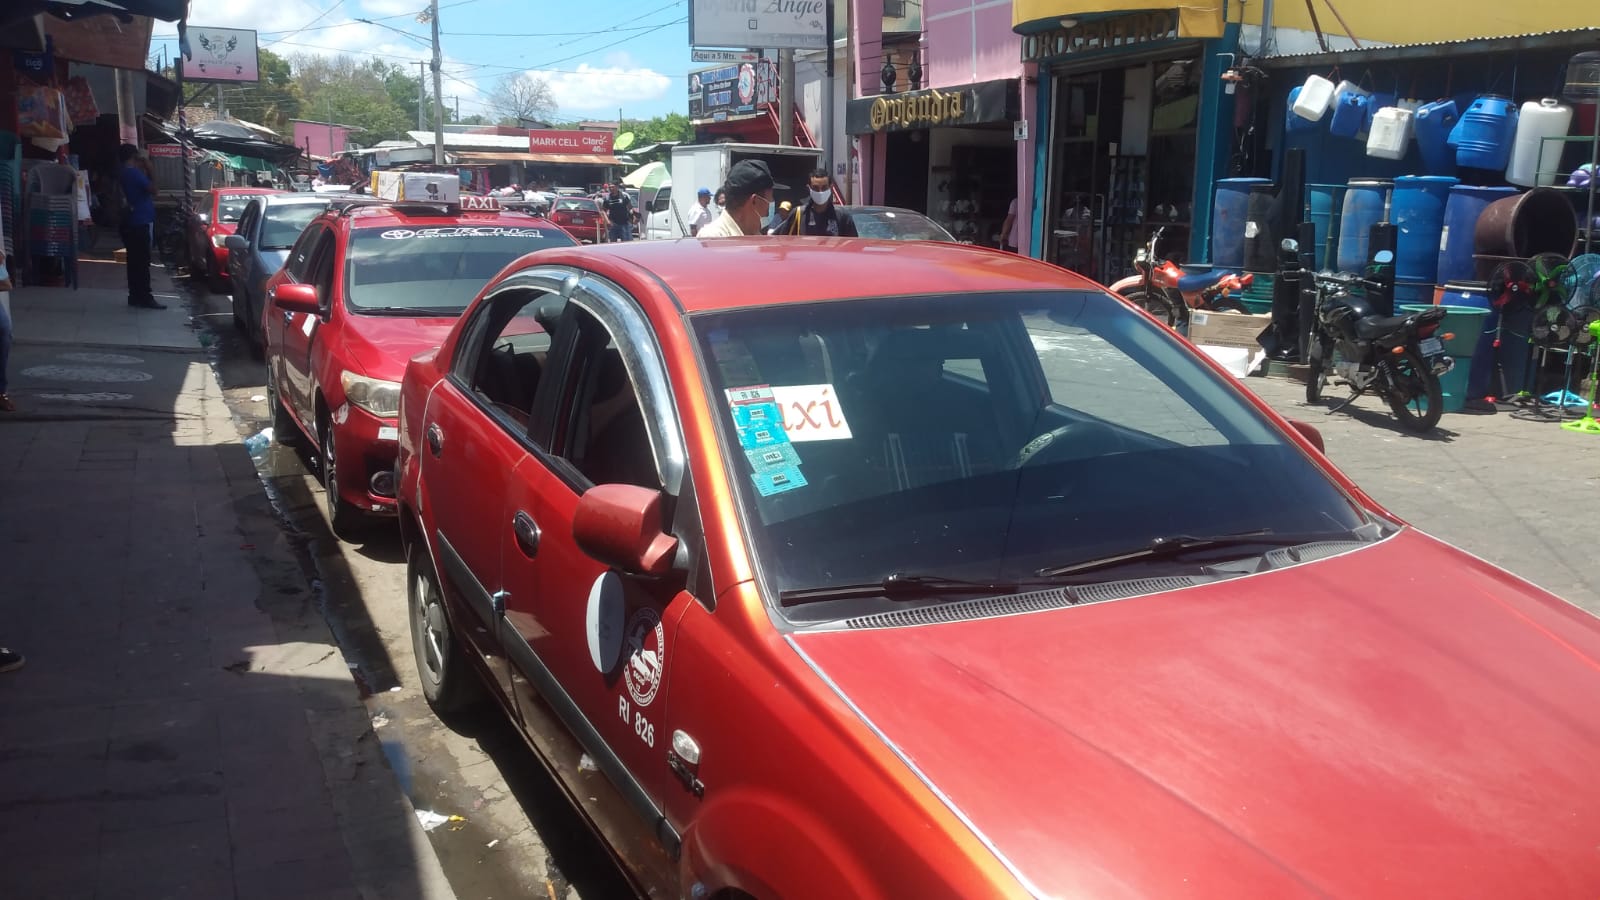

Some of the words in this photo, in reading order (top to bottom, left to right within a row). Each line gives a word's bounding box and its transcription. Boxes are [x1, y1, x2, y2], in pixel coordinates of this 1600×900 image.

[871, 89, 965, 131] Orolandia
[532, 137, 557, 146] MARK
[558, 138, 579, 147] CELL
[582, 136, 604, 145] Claro
[460, 197, 494, 210] TAXI
[619, 694, 630, 725] RI
[634, 711, 655, 748] 826
